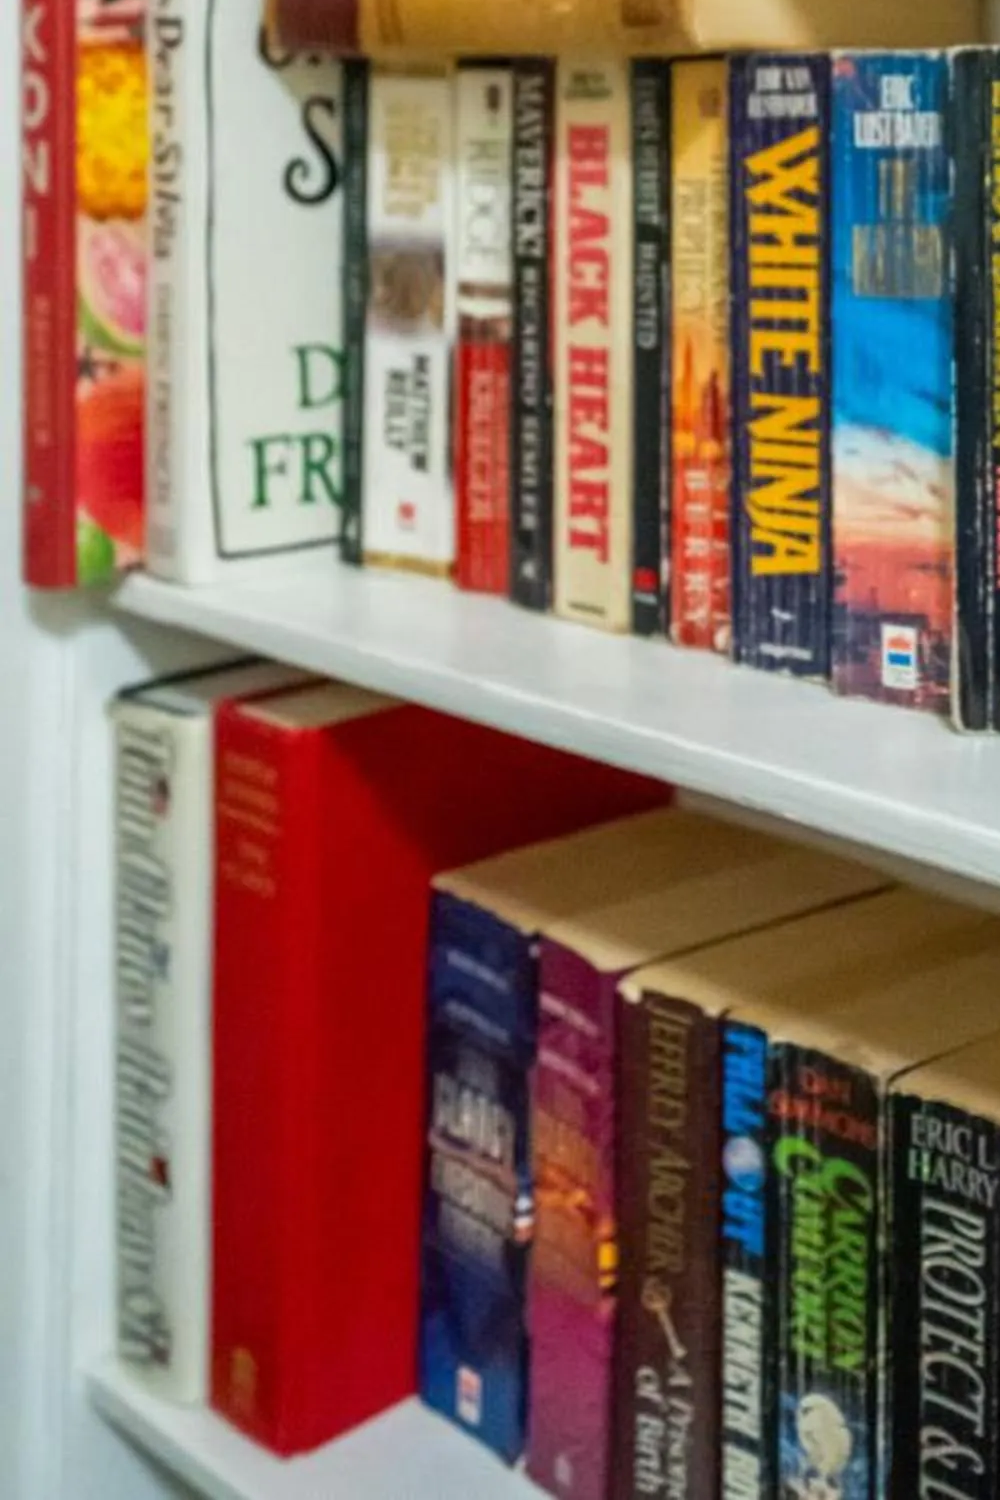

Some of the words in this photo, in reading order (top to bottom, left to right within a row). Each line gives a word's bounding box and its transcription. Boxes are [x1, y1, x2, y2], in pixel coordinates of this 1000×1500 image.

[566, 123, 612, 327] BLACK
[744, 124, 820, 376] WHITE
[567, 347, 610, 565] HEART
[745, 391, 821, 577] NINJA
[649, 1002, 694, 1138] JEFFREY
[909, 1112, 974, 1160] ERIC
[648, 1143, 692, 1275] ARCHER
[906, 1147, 1000, 1209] HARRY
[722, 1268, 763, 1441] KENNETH
[921, 1196, 987, 1438] PROTECT
[634, 1412, 666, 1495] Birth
[919, 1425, 985, 1476] &
